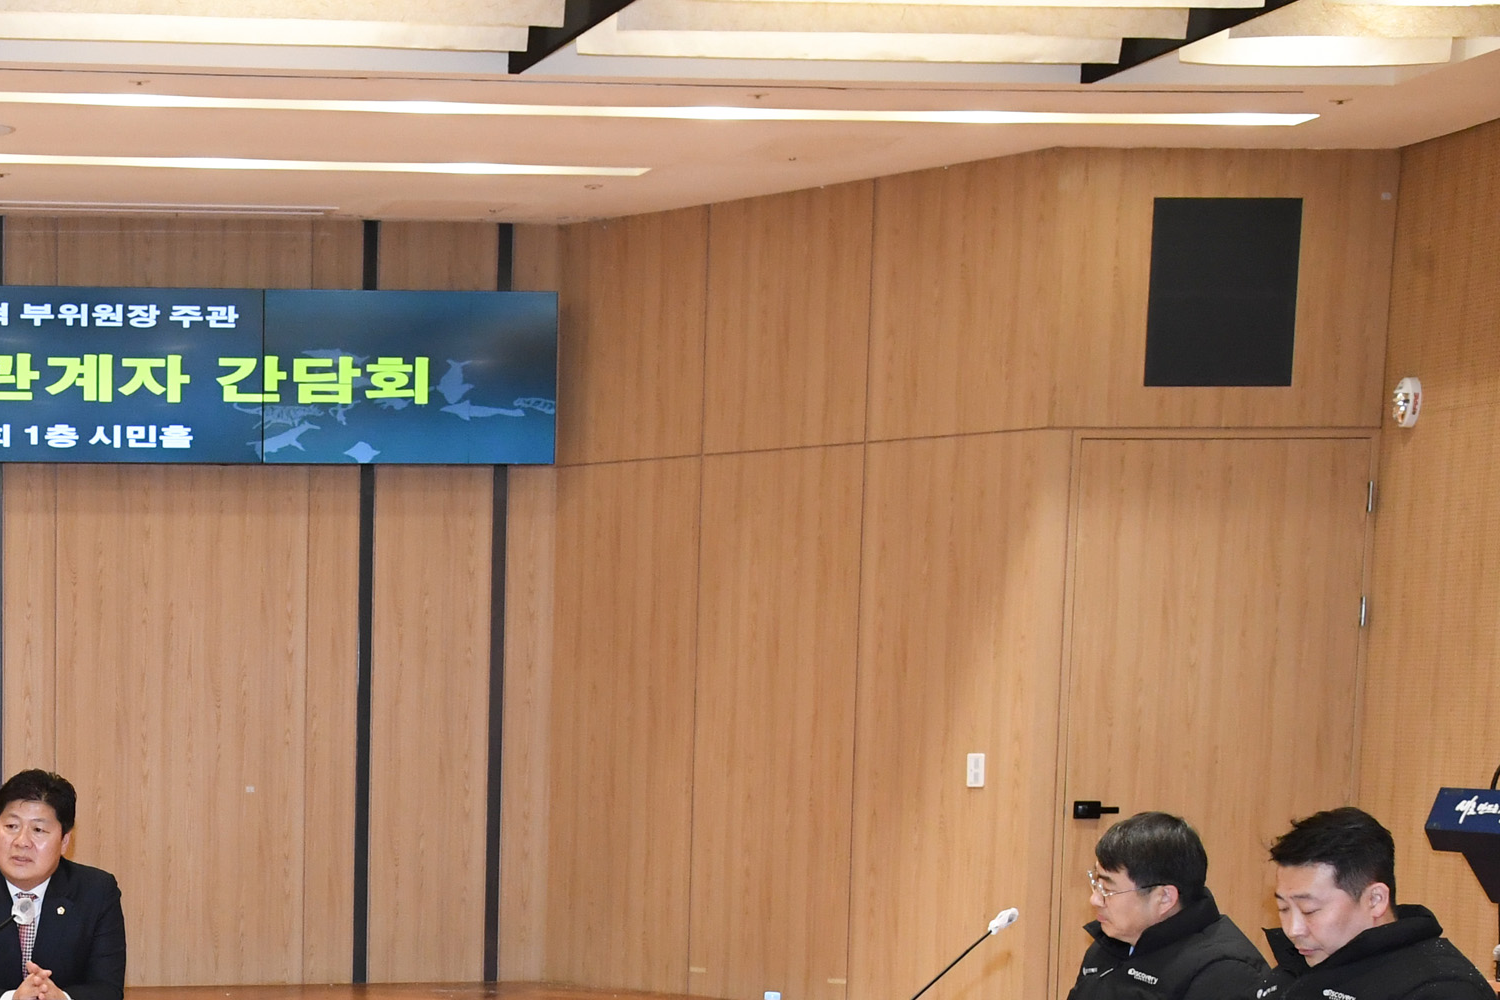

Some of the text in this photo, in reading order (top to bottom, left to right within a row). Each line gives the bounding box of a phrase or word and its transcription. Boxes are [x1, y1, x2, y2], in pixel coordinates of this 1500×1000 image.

[20, 303, 161, 328] 부위원장
[169, 306, 239, 329] 주관
[218, 355, 430, 406] 간담회
[24, 425, 79, 448] 1층
[88, 425, 194, 449] 시민홀
